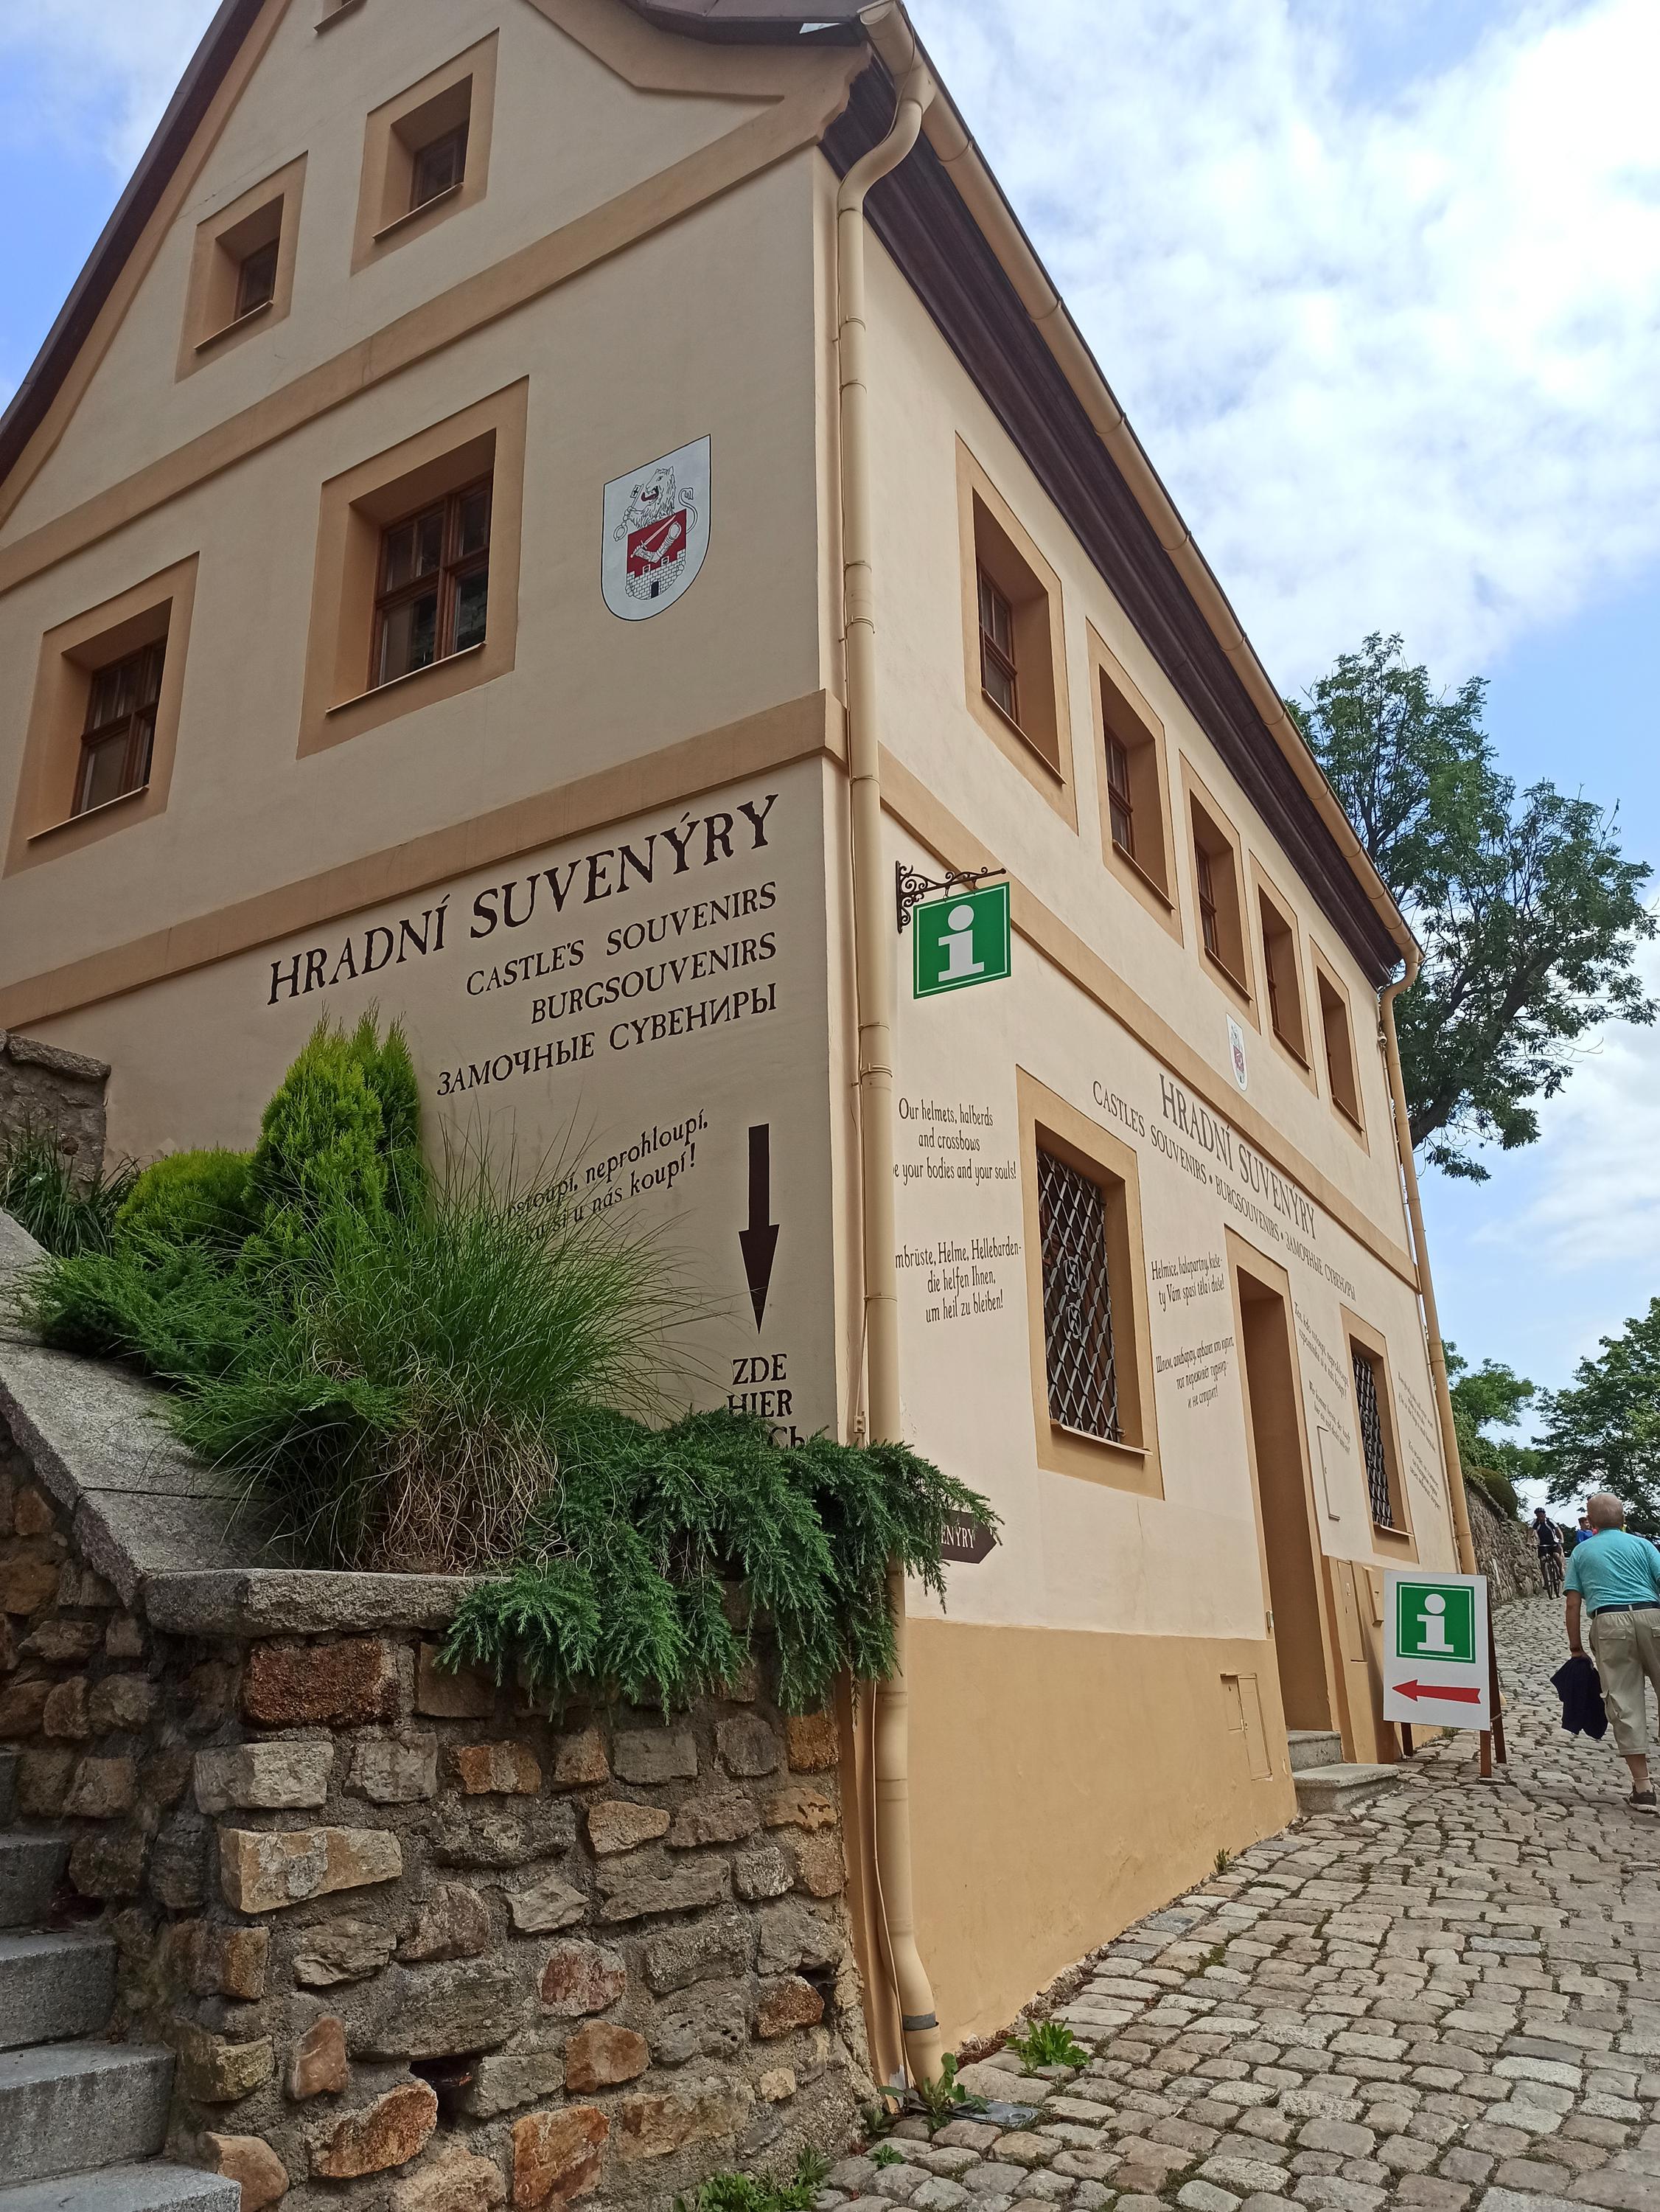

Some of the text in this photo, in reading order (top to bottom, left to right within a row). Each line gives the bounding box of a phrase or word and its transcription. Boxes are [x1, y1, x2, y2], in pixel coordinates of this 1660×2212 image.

[267, 793, 779, 1006] HRADNÍ SUVENÝRY
[467, 881, 777, 996] CASTLE'S SOUVENIRS
[531, 932, 777, 1025] BURGSOUVENIRS
[436, 983, 777, 1096] ЗАМОЧНЫЕ СУВЕНИРЫ
[899, 1097, 994, 1126] Our helmets, halberds
[585, 1108, 708, 1184] neprohloupí,
[918, 1126, 980, 1151] and crossbows
[902, 1164, 924, 1186] your
[927, 1156, 955, 1179] bodies
[957, 1158, 972, 1179] and
[974, 1166, 993, 1186] your
[995, 1161, 1016, 1180] souls!
[1159, 1073, 1317, 1240] HRADNÍ SUVENÝRY
[1151, 1124, 1207, 1184] SOUVENIRS
[1216, 1175, 1280, 1242] BURGSOUVENIRS
[573, 1205, 584, 1222] u
[593, 1186, 623, 1214] nás
[895, 1244, 936, 1269] mbrüste,
[938, 1240, 969, 1264] Helme,
[1151, 1259, 1179, 1280] Helmice,
[927, 1265, 996, 1297] die helfen Ihnen,
[925, 1288, 1003, 1323] um heil zu bleiben!
[1159, 1290, 1166, 1312] ty
[1166, 1284, 1181, 1302] Vám
[732, 1353, 787, 1385] ZDE
[726, 1389, 792, 1417] HIER
[941, 1522, 974, 1548] ENÝRY
